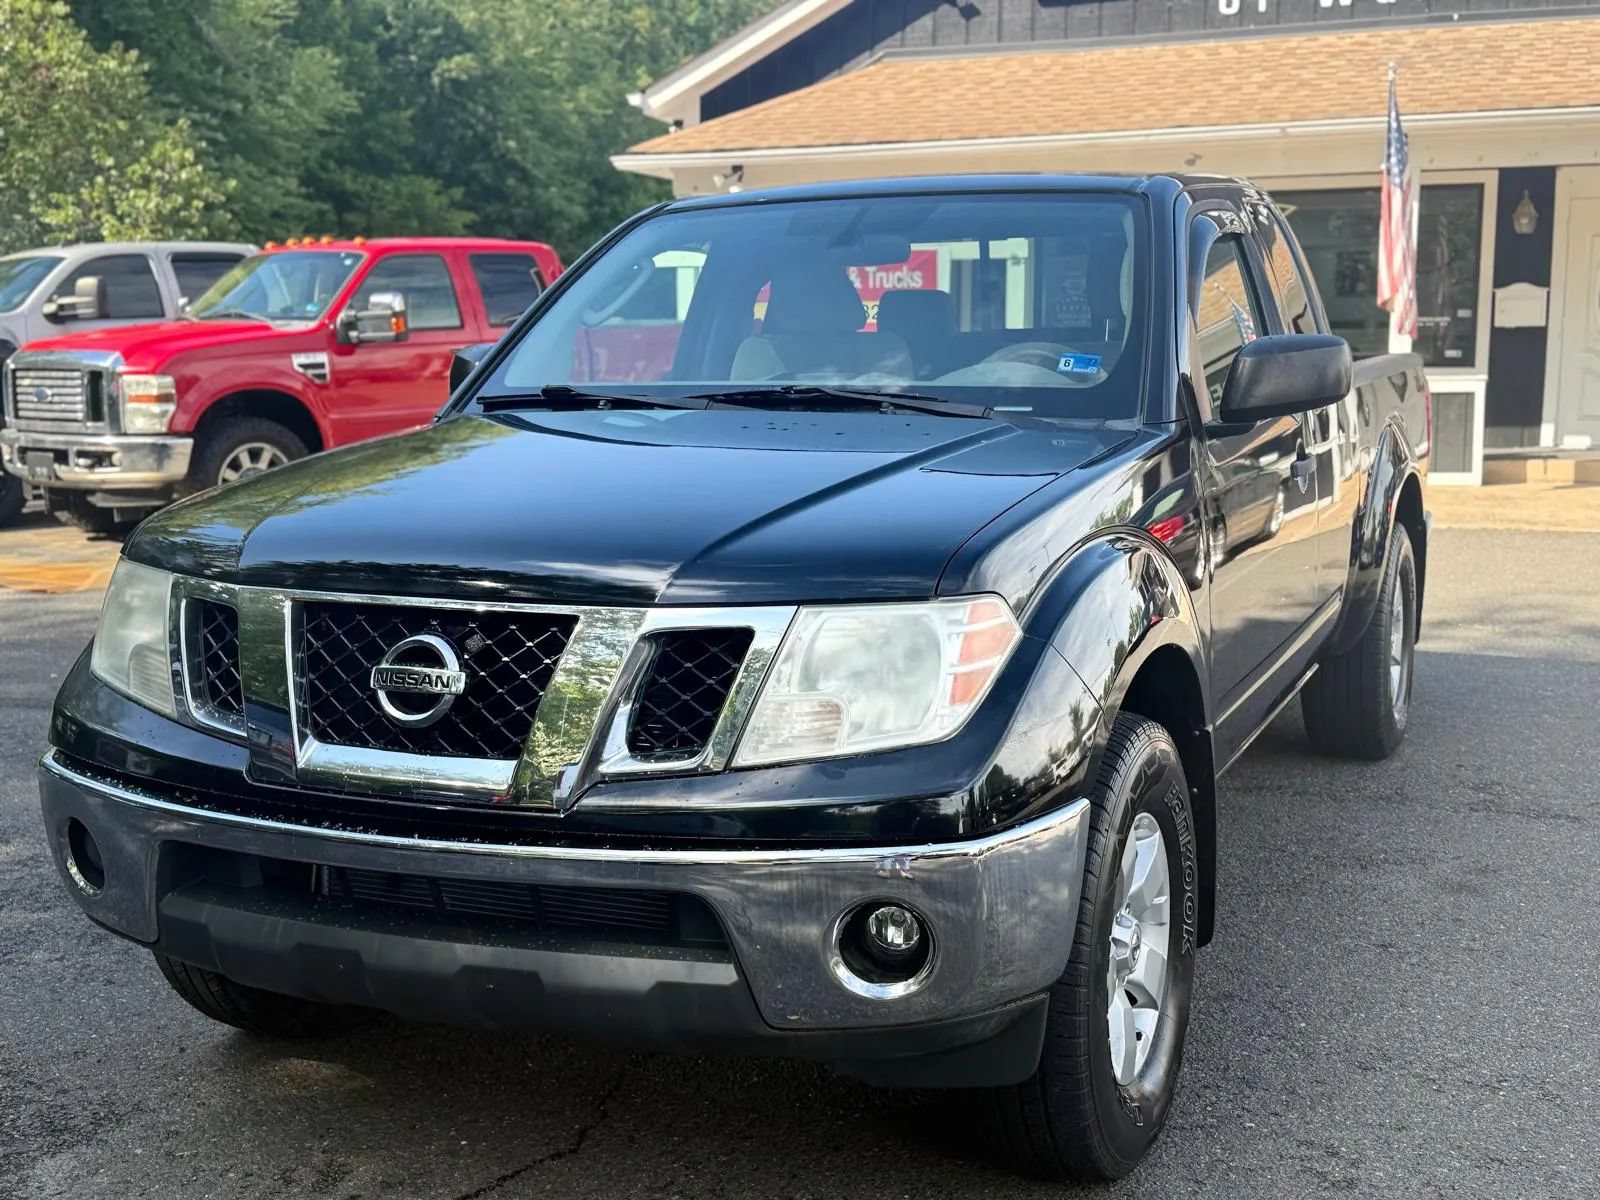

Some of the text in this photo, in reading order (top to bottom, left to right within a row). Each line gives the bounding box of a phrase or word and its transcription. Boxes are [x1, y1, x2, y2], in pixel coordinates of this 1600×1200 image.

[864, 266, 924, 289] Trucks
[1063, 358, 1072, 368] 6
[374, 671, 452, 689] NISSAN
